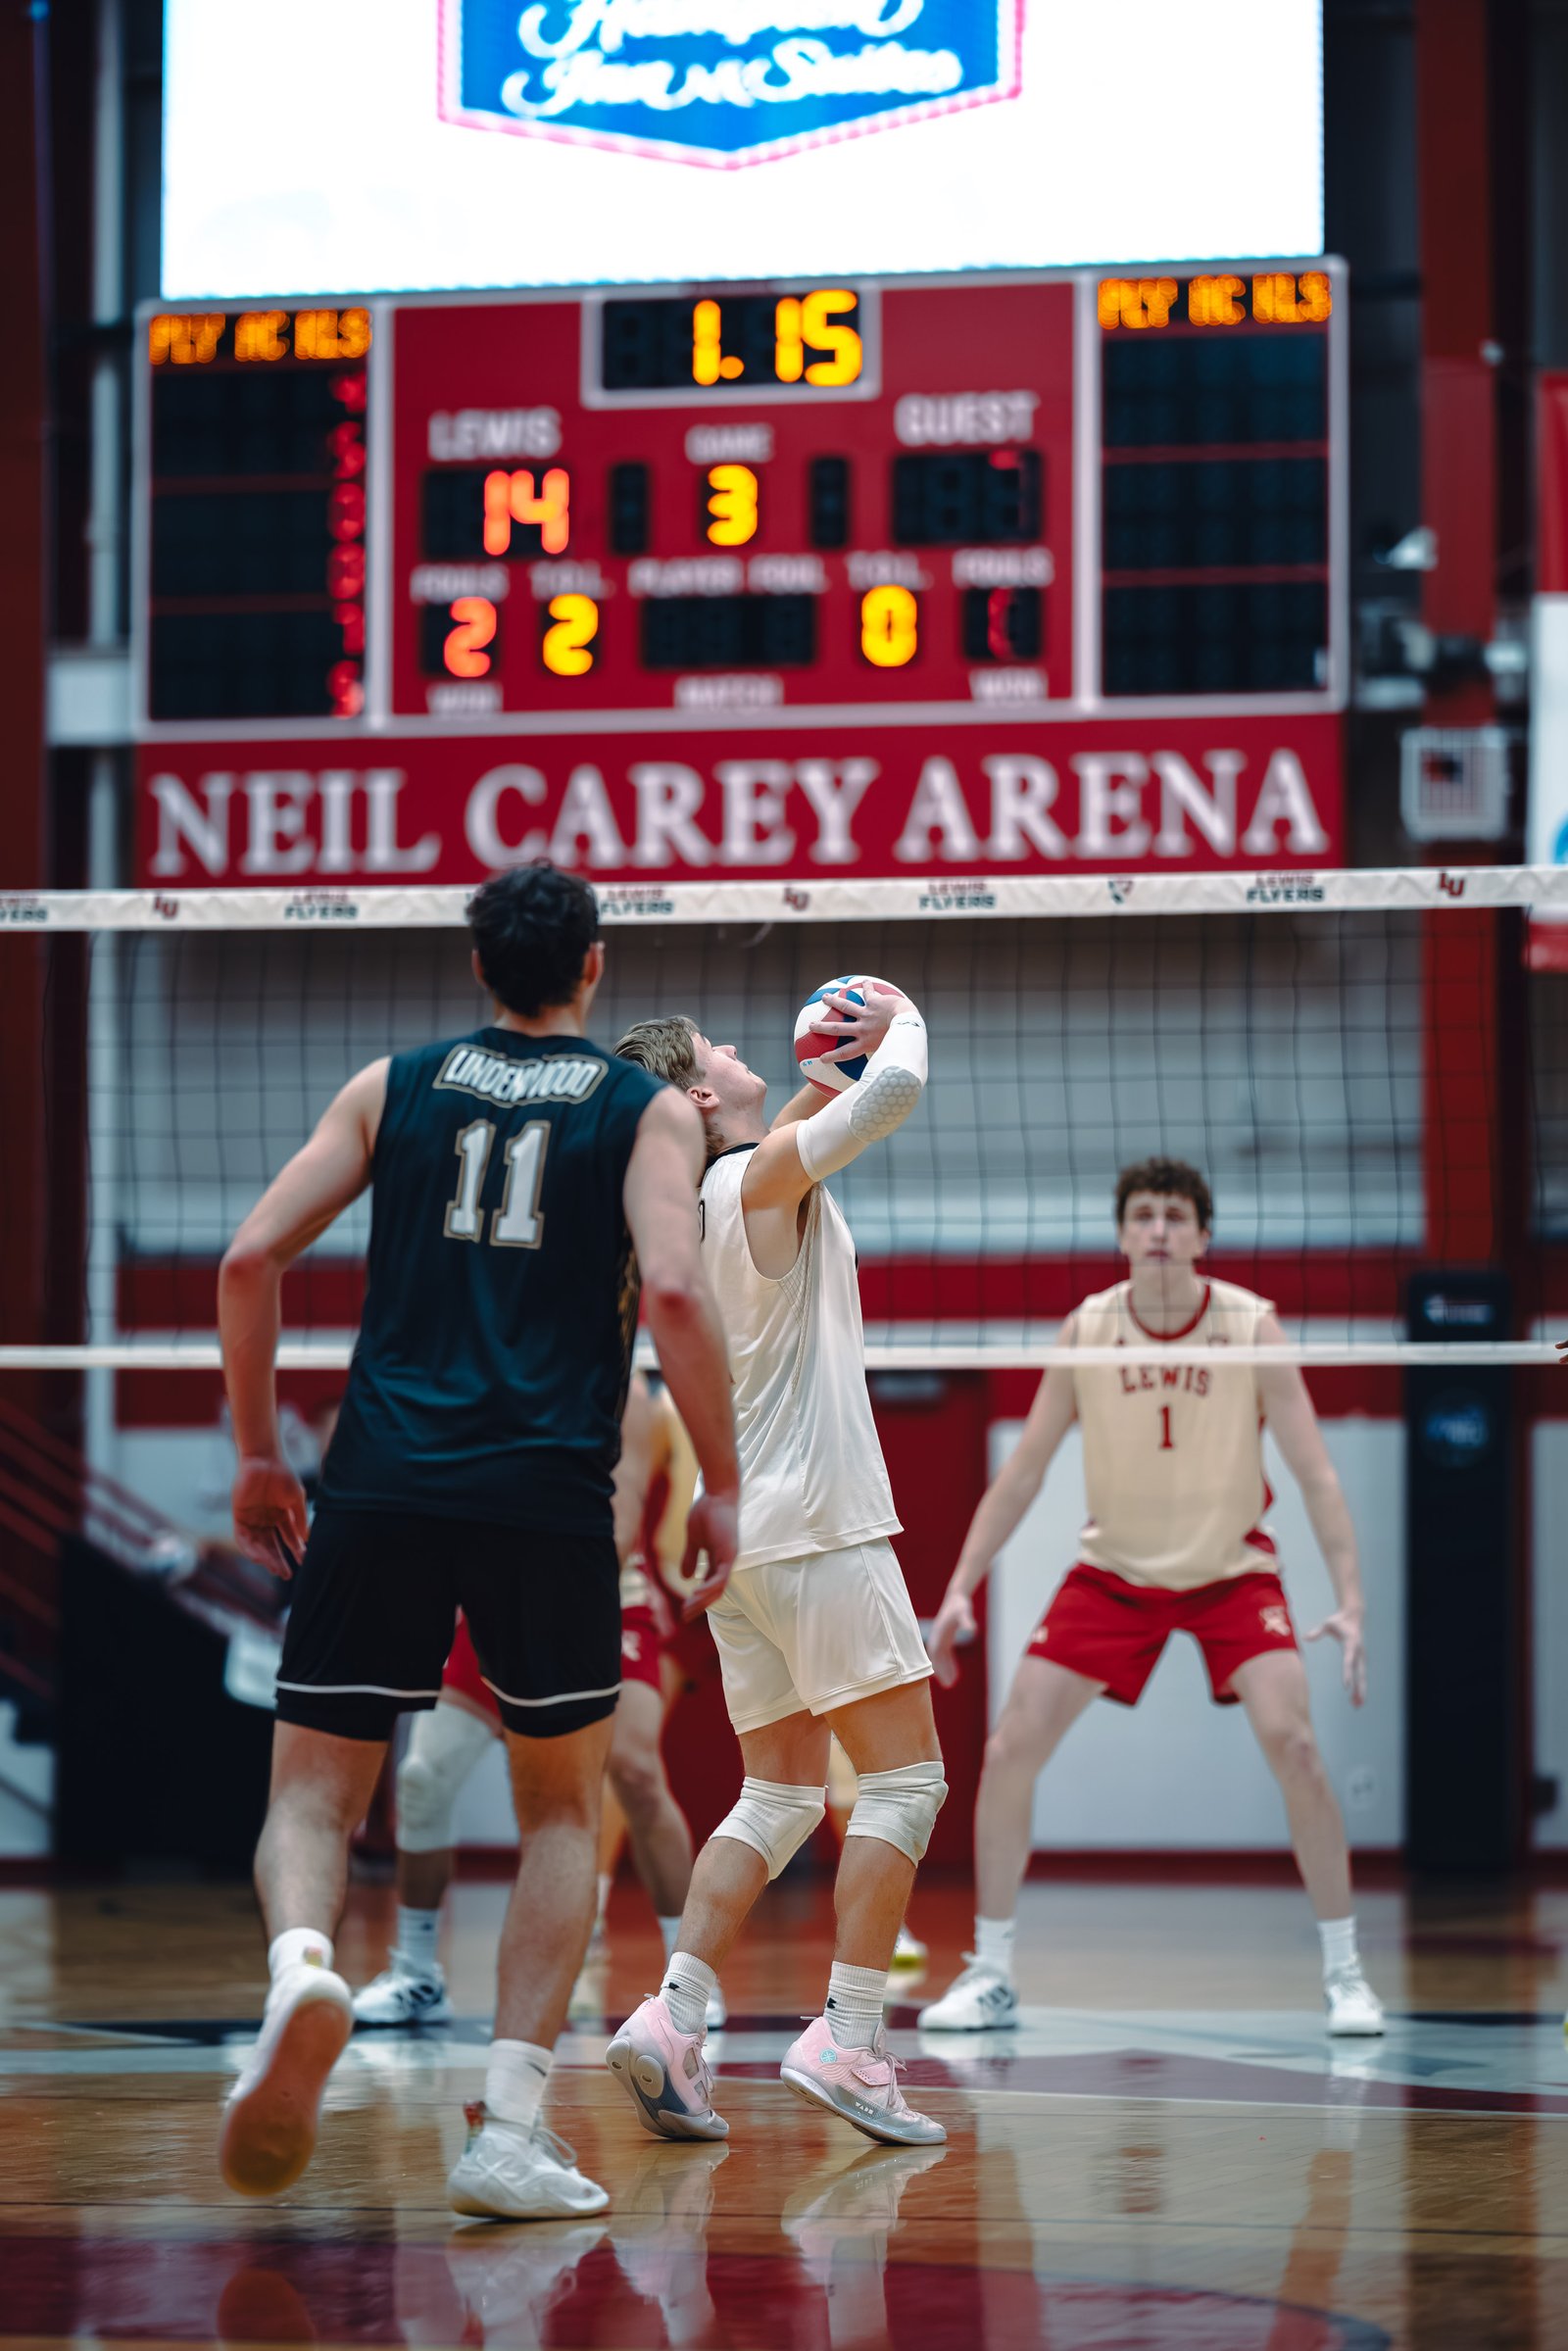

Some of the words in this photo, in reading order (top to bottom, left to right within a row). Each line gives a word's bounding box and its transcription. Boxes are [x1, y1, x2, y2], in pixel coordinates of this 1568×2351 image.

[428, 406, 562, 462] LEWIS
[894, 390, 1040, 446] GUEST
[483, 468, 569, 555] 14
[708, 465, 758, 546] 3
[444, 597, 497, 677] 2
[543, 593, 599, 675] 2
[861, 584, 917, 666] 0
[150, 770, 441, 876] NEIL
[465, 759, 879, 869] CAREY
[894, 751, 1328, 862] ARENA
[918, 894, 997, 910] FLYERS
[927, 878, 986, 894] LEWIS
[1247, 886, 1324, 903] FLYERS
[1255, 871, 1315, 887] LEWIS
[1439, 869, 1466, 898] LU
[283, 904, 360, 920] FLYERS
[599, 900, 674, 915] FLYERS
[437, 1046, 606, 1105] LINDENWOOD
[445, 1121, 550, 1247] 11
[1119, 1365, 1210, 1397] LEWIS
[1159, 1403, 1175, 1449] 1
